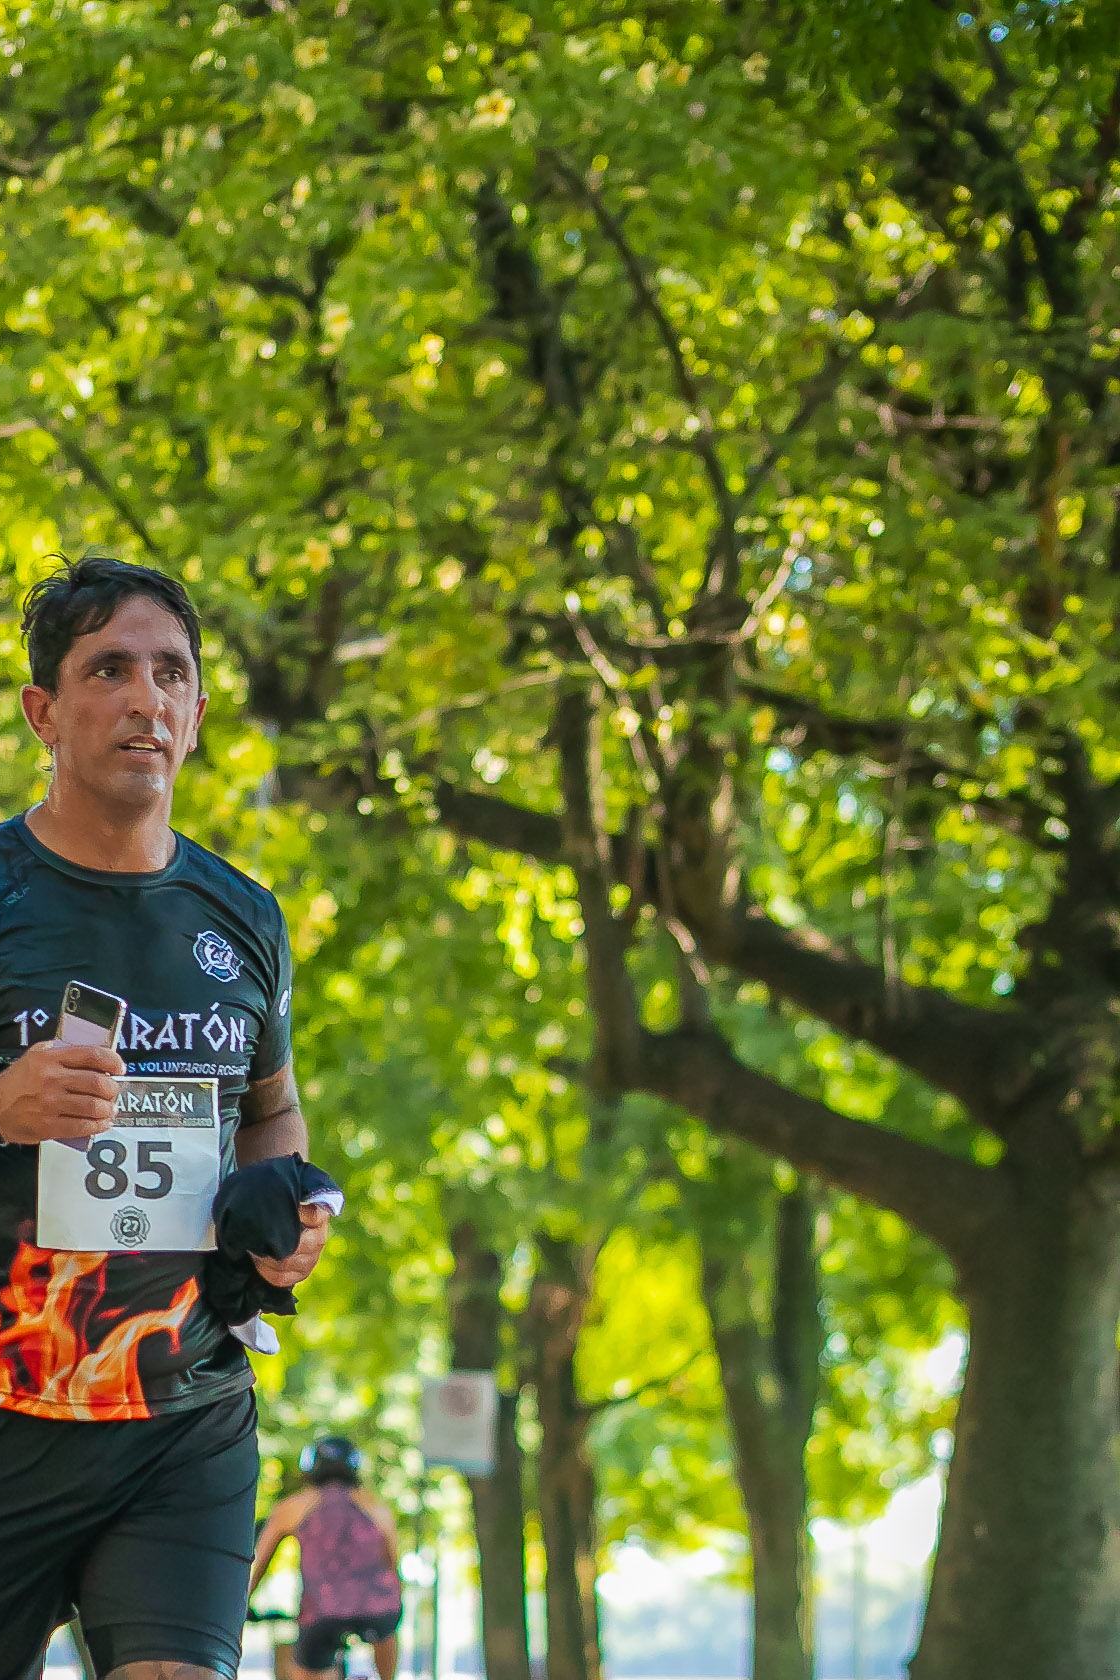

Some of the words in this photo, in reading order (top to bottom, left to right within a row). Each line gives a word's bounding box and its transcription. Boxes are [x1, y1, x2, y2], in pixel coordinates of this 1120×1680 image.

[116, 1002, 247, 1053] RATÓN
[137, 1061, 218, 1075] VOLUNTARIOS
[114, 1085, 195, 1114] ARATÓN
[84, 1139, 174, 1200] 85
[122, 1218, 139, 1233] 27
